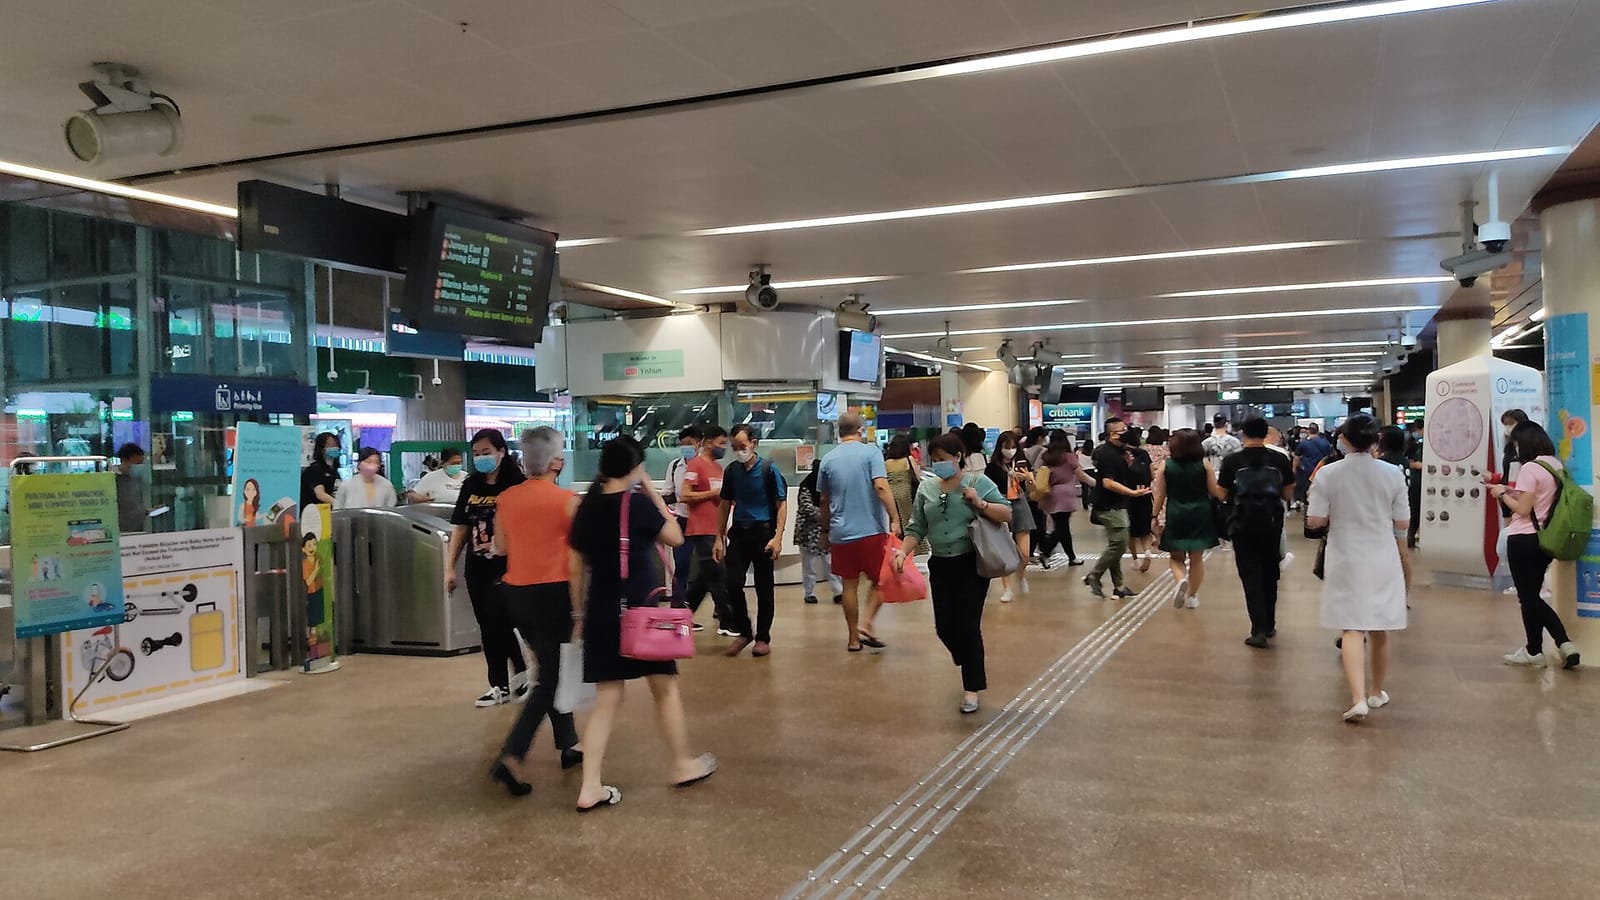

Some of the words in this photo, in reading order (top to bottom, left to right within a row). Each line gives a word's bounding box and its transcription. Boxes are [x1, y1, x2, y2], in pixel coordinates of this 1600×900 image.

[469, 244, 482, 254] East
[468, 254, 480, 265] East
[442, 278, 462, 290] Marina
[462, 281, 478, 292] South
[479, 284, 490, 294] Pier
[441, 289, 460, 301] Marina
[460, 292, 477, 303] South
[478, 295, 488, 305] Pier
[465, 307, 483, 318] Please
[483, 311, 491, 319] do
[492, 312, 500, 320] not
[501, 313, 514, 322] leave
[234, 402, 253, 410] Priority
[1048, 408, 1084, 417] citibank
